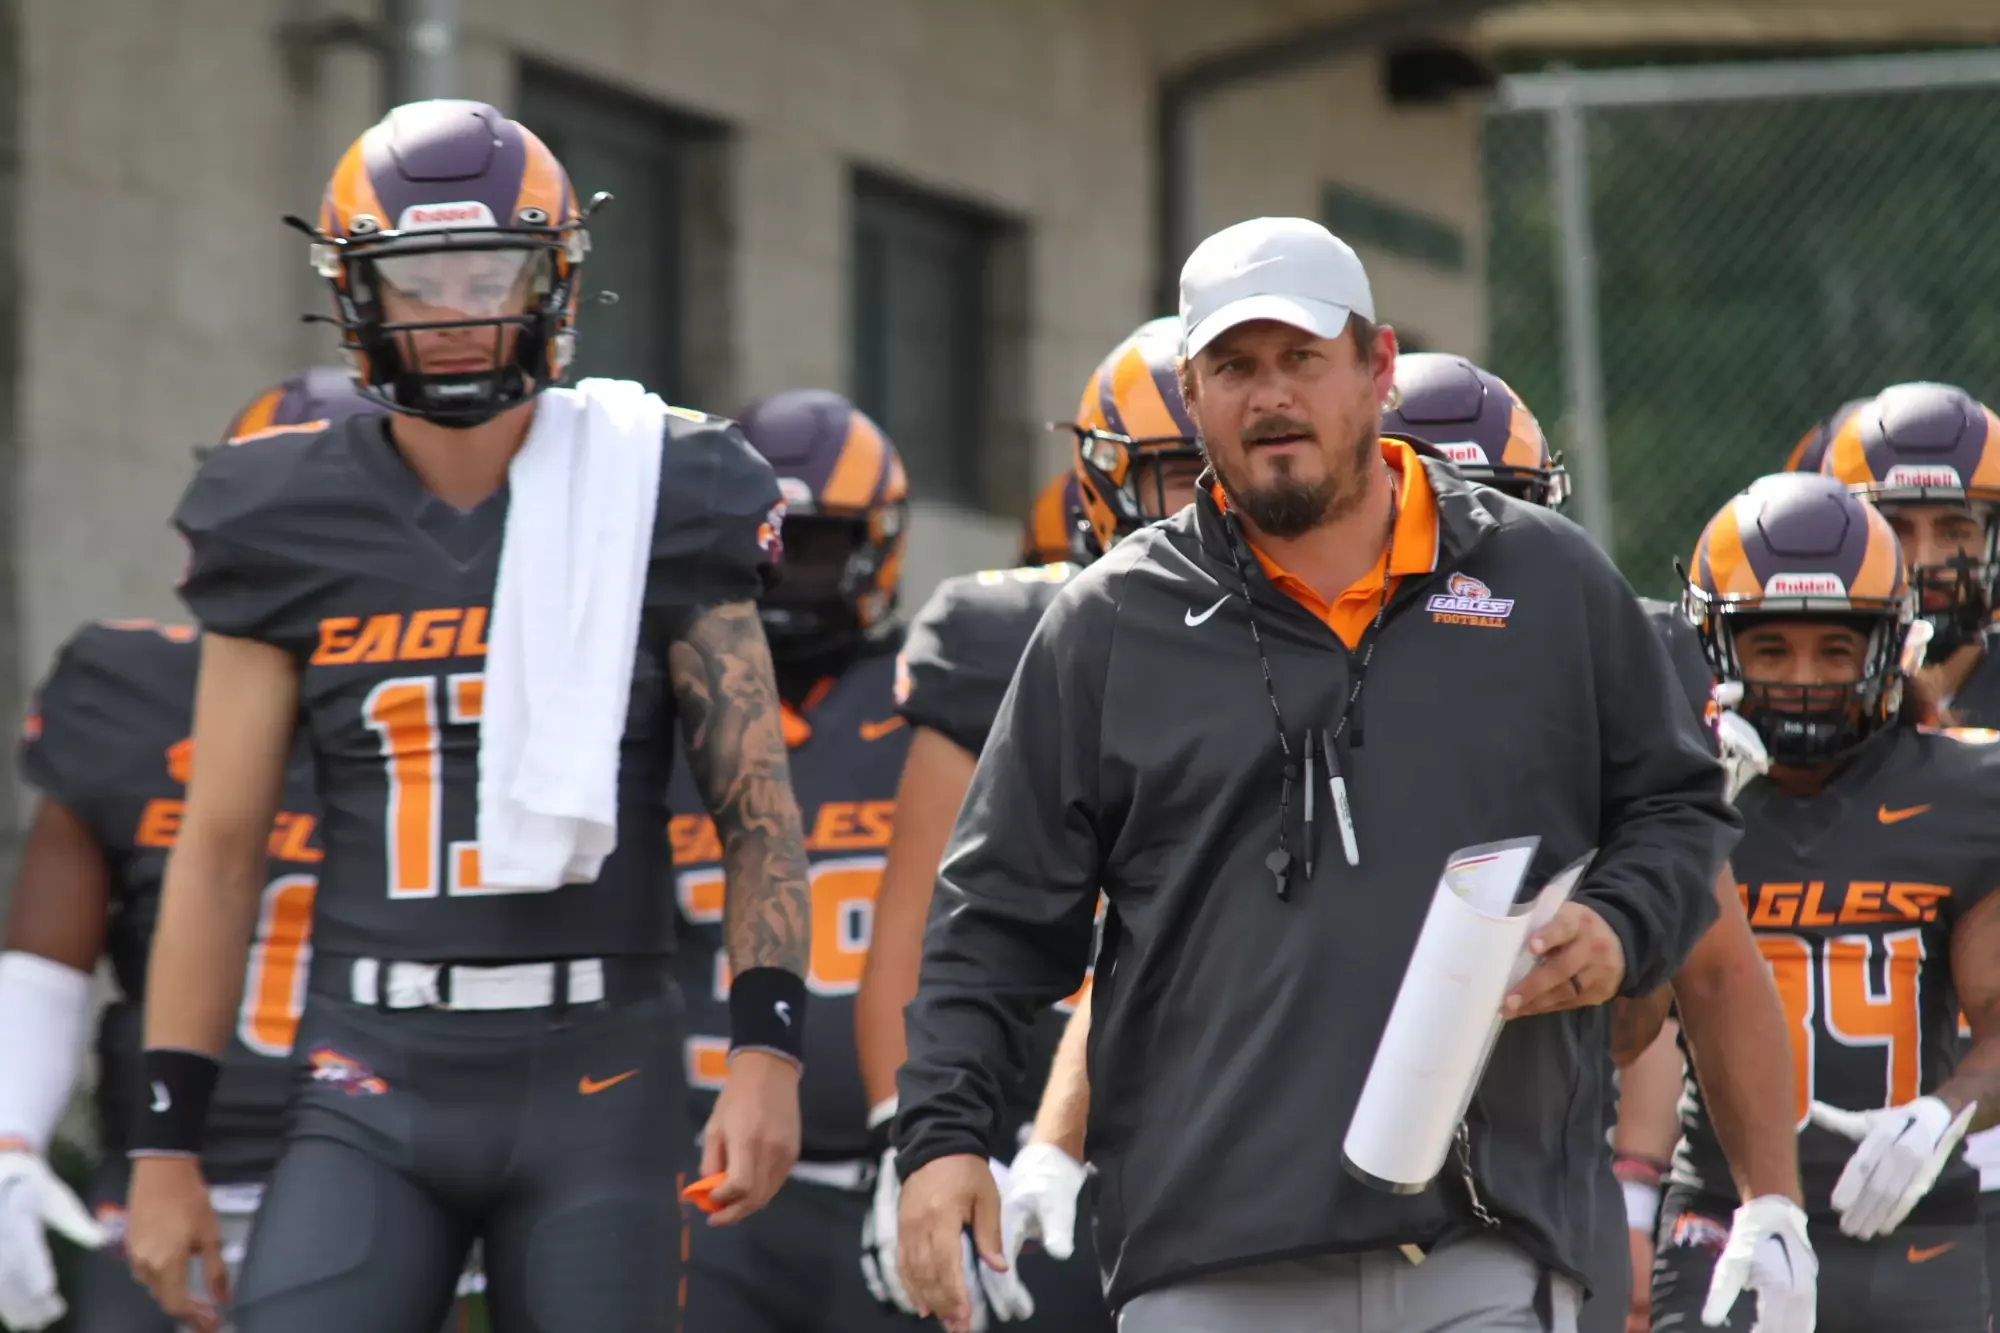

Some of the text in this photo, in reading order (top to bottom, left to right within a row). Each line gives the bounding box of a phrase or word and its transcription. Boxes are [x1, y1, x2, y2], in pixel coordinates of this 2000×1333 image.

[1774, 580, 1837, 593] Riddell
[1431, 597, 1508, 613] EAGLES
[1432, 612, 1507, 629] FOOTBALL
[308, 606, 489, 666] EAGL
